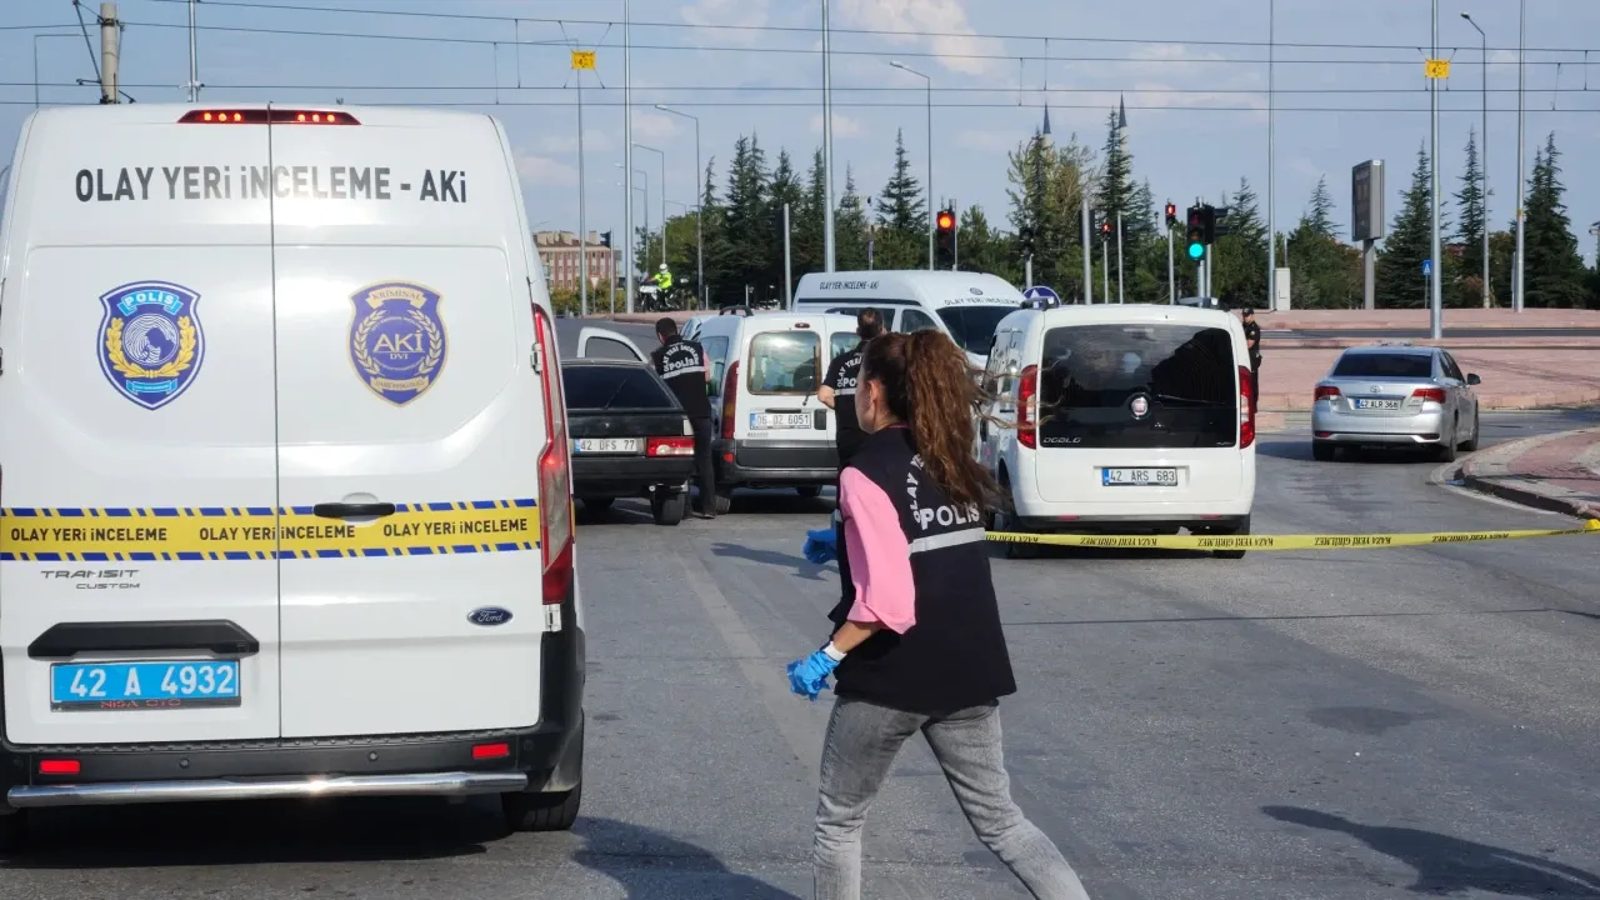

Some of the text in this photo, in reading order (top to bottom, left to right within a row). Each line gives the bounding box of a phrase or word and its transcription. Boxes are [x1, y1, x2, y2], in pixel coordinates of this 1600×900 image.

[75, 167, 154, 202] OLAY
[400, 183, 411, 191] -
[372, 330, 423, 352] AKİ
[580, 440, 636, 451] 42 DFS 77
[1111, 470, 1175, 481] 42 ARS 683
[907, 453, 925, 524] OLAY YE
[10, 528, 49, 542] OLAY
[200, 527, 238, 541] OLAY
[383, 522, 420, 537] OLAY
[1137, 537, 1158, 546] KAZA
[1254, 537, 1274, 547] KAZA
[1371, 536, 1391, 545] KAZA
[40, 569, 140, 579] TRANSIT
[478, 608, 504, 622] Ford
[70, 664, 234, 698] 42 A 4932
